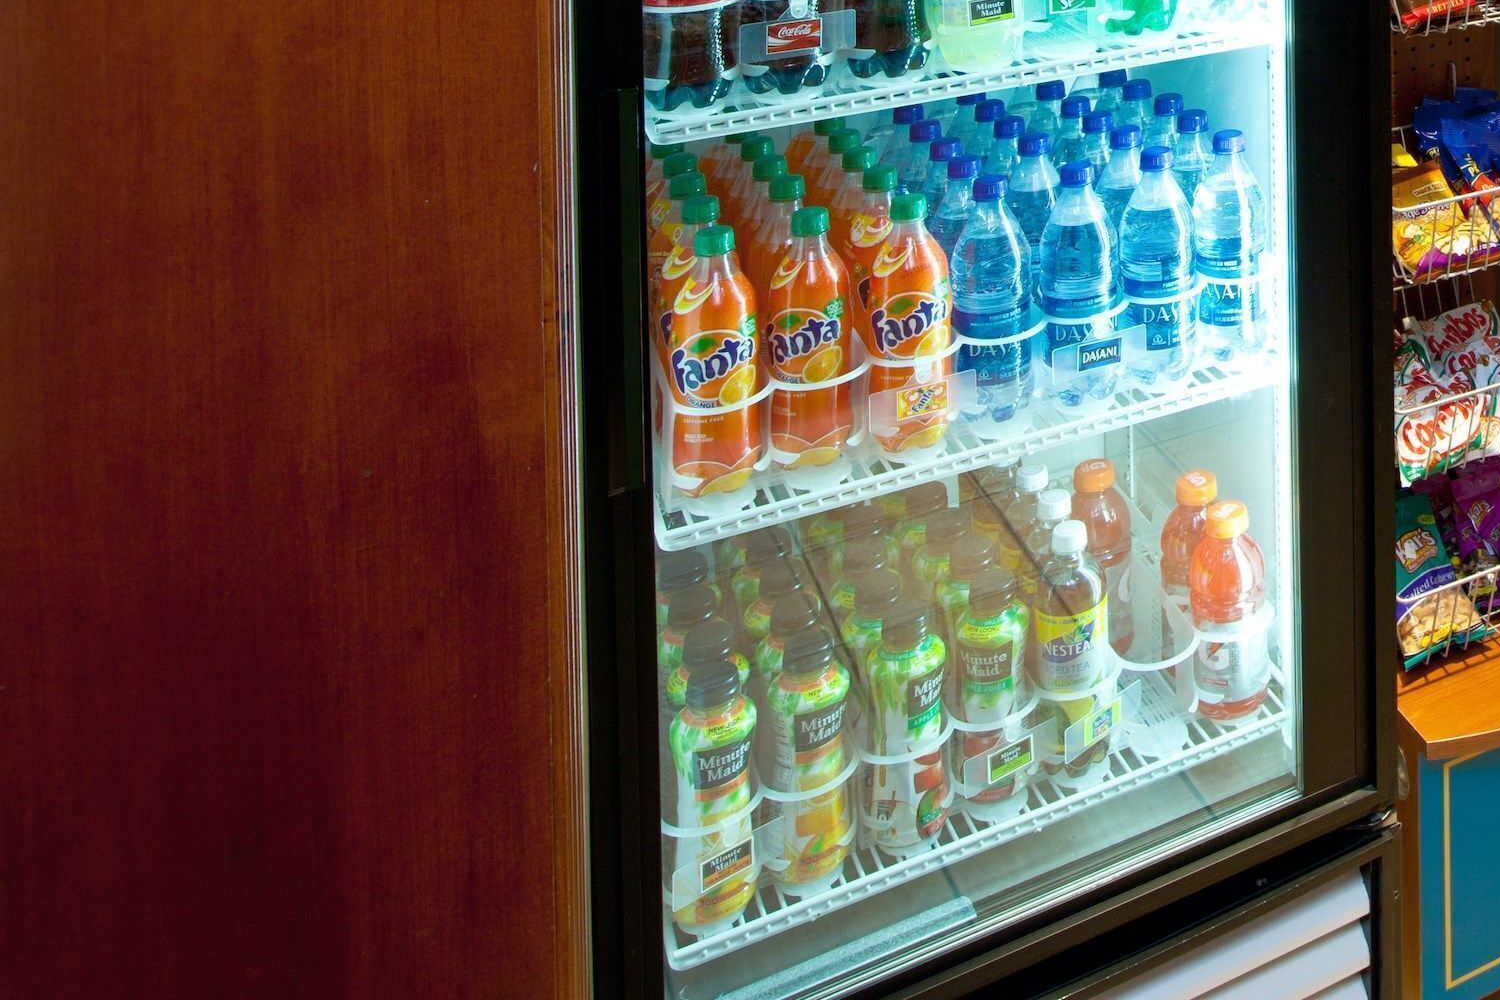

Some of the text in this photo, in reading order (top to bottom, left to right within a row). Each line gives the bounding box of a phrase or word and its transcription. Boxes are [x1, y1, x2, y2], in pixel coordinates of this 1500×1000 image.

[976, 1, 1005, 11] Minute
[981, 8, 1002, 18] Maid
[870, 300, 947, 353] Fanta
[765, 318, 841, 365] Fanta
[1082, 345, 1118, 364] DASANI
[671, 337, 754, 394] Fanta
[686, 396, 716, 409] ORANGE
[911, 387, 934, 414] Fanta
[961, 651, 1007, 665] Minute
[1043, 641, 1091, 657] NESTEA
[966, 664, 1000, 677] Maid
[1071, 662, 1090, 672] TEA
[809, 715, 841, 744] Maid
[699, 741, 750, 770] Minute
[707, 755, 744, 782] Maid
